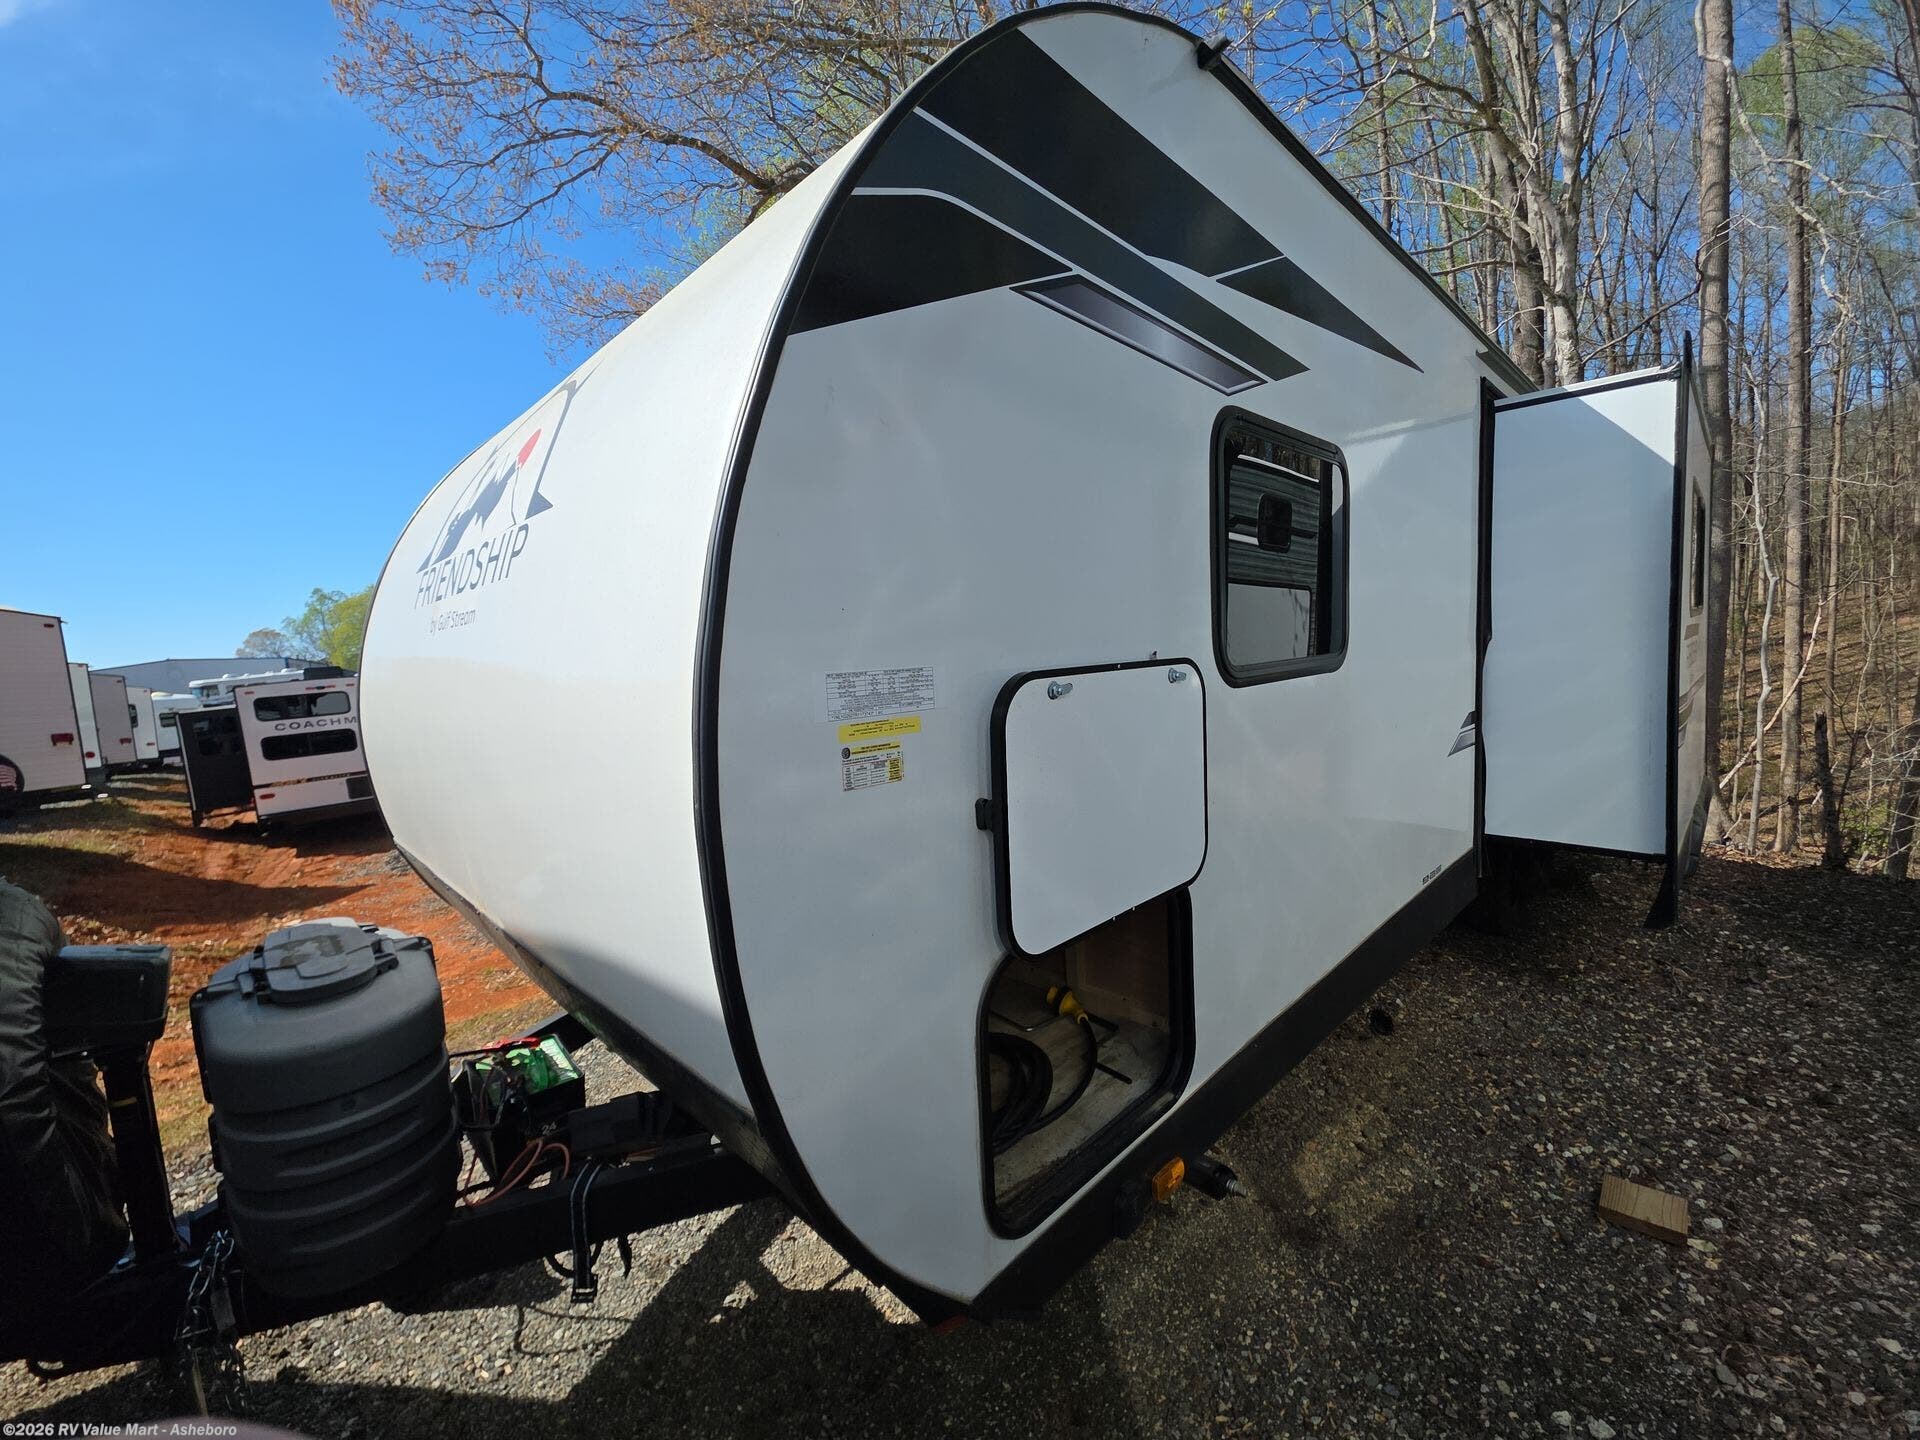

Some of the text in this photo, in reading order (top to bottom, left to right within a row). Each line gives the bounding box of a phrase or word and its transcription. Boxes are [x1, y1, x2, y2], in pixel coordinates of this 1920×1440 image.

[414, 523, 530, 609] FRIENDSHIP
[450, 609, 477, 629] Stream
[274, 716, 357, 731] COACHM
